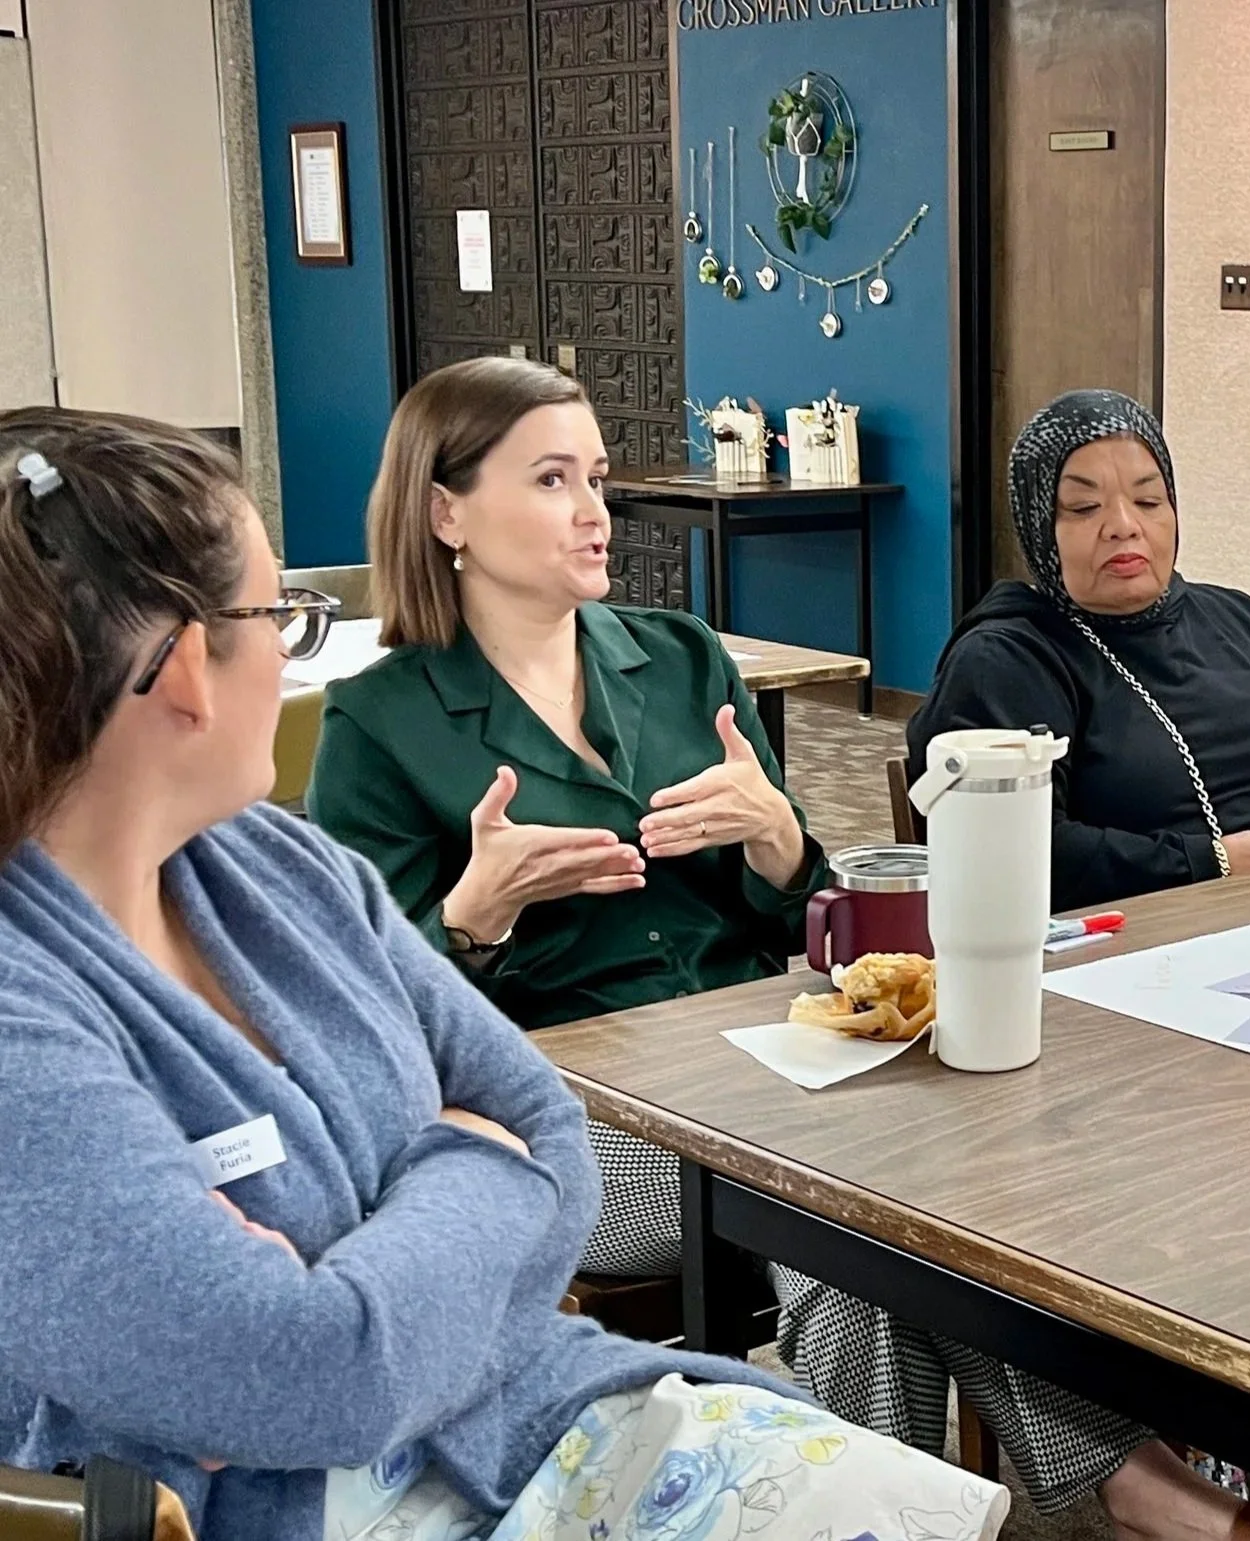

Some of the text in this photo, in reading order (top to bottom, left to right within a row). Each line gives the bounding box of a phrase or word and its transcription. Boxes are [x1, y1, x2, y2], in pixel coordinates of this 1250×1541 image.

[676, 0, 811, 30] CROSSMAN
[213, 1139, 250, 1158] Stacie
[220, 1153, 252, 1171] Furia
